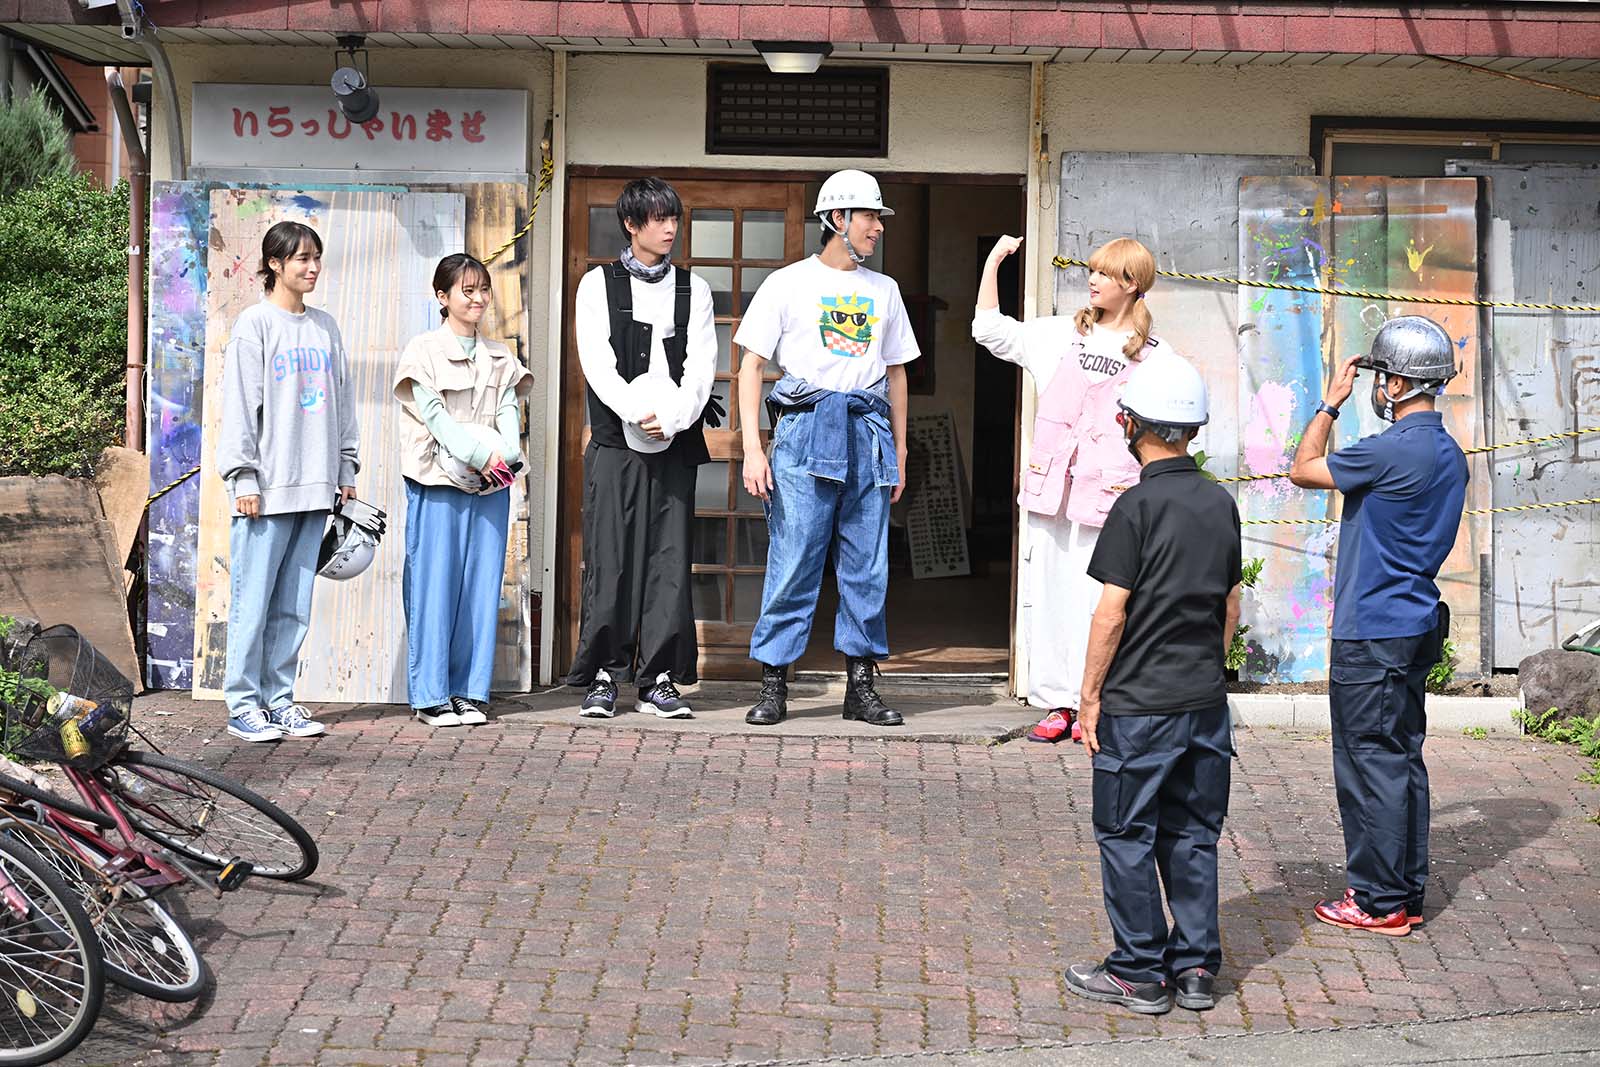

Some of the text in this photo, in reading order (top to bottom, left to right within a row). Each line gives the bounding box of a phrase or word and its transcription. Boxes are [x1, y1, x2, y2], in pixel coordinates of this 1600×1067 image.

[232, 106, 486, 143] いらっしゃいませ
